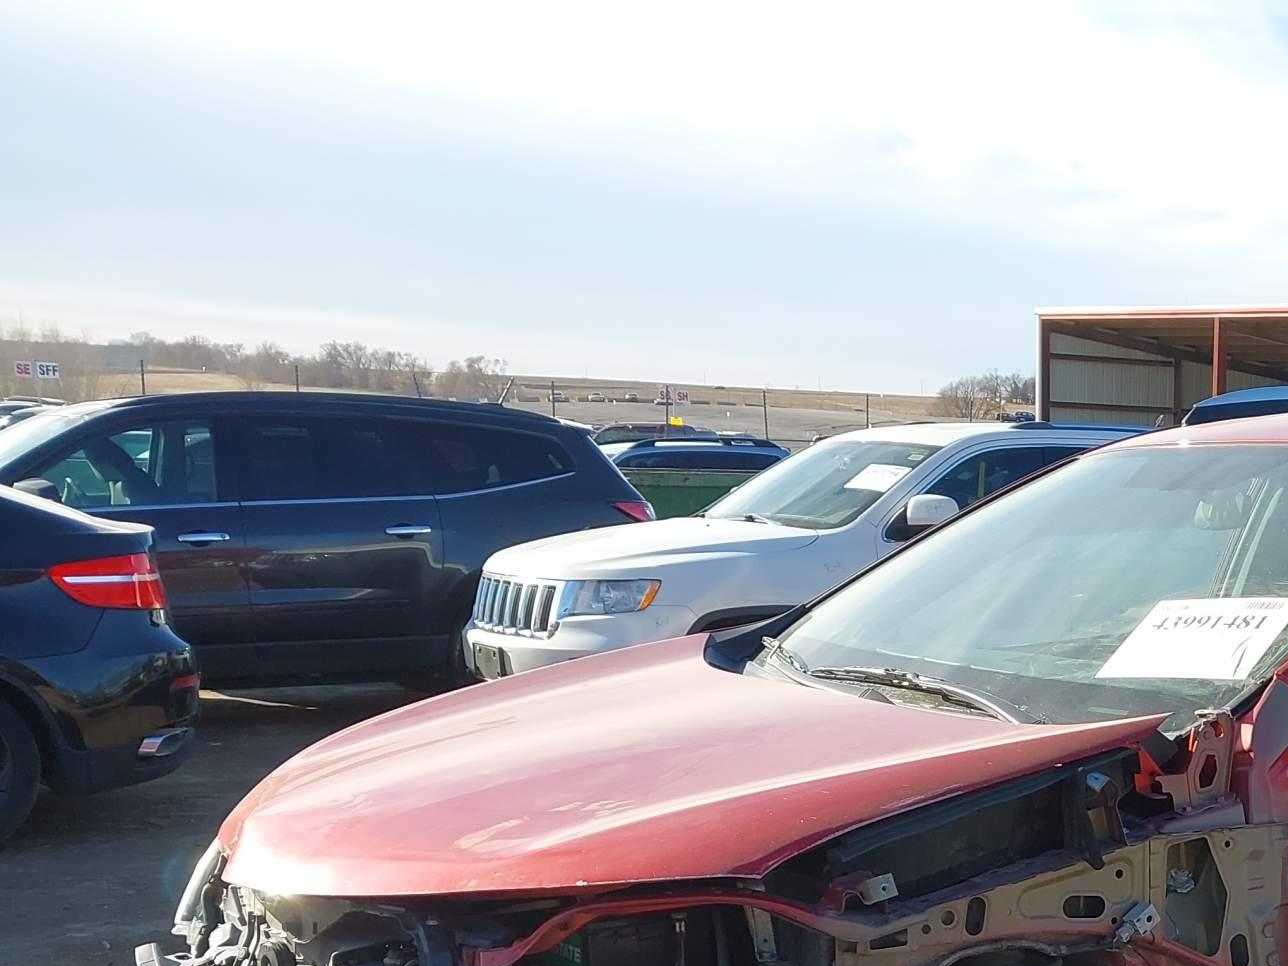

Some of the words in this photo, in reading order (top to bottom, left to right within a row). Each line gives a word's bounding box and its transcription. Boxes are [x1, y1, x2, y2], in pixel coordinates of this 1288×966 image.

[16, 363, 31, 375] SE
[677, 391, 689, 401] SH
[1152, 615, 1268, 631] 43991481
